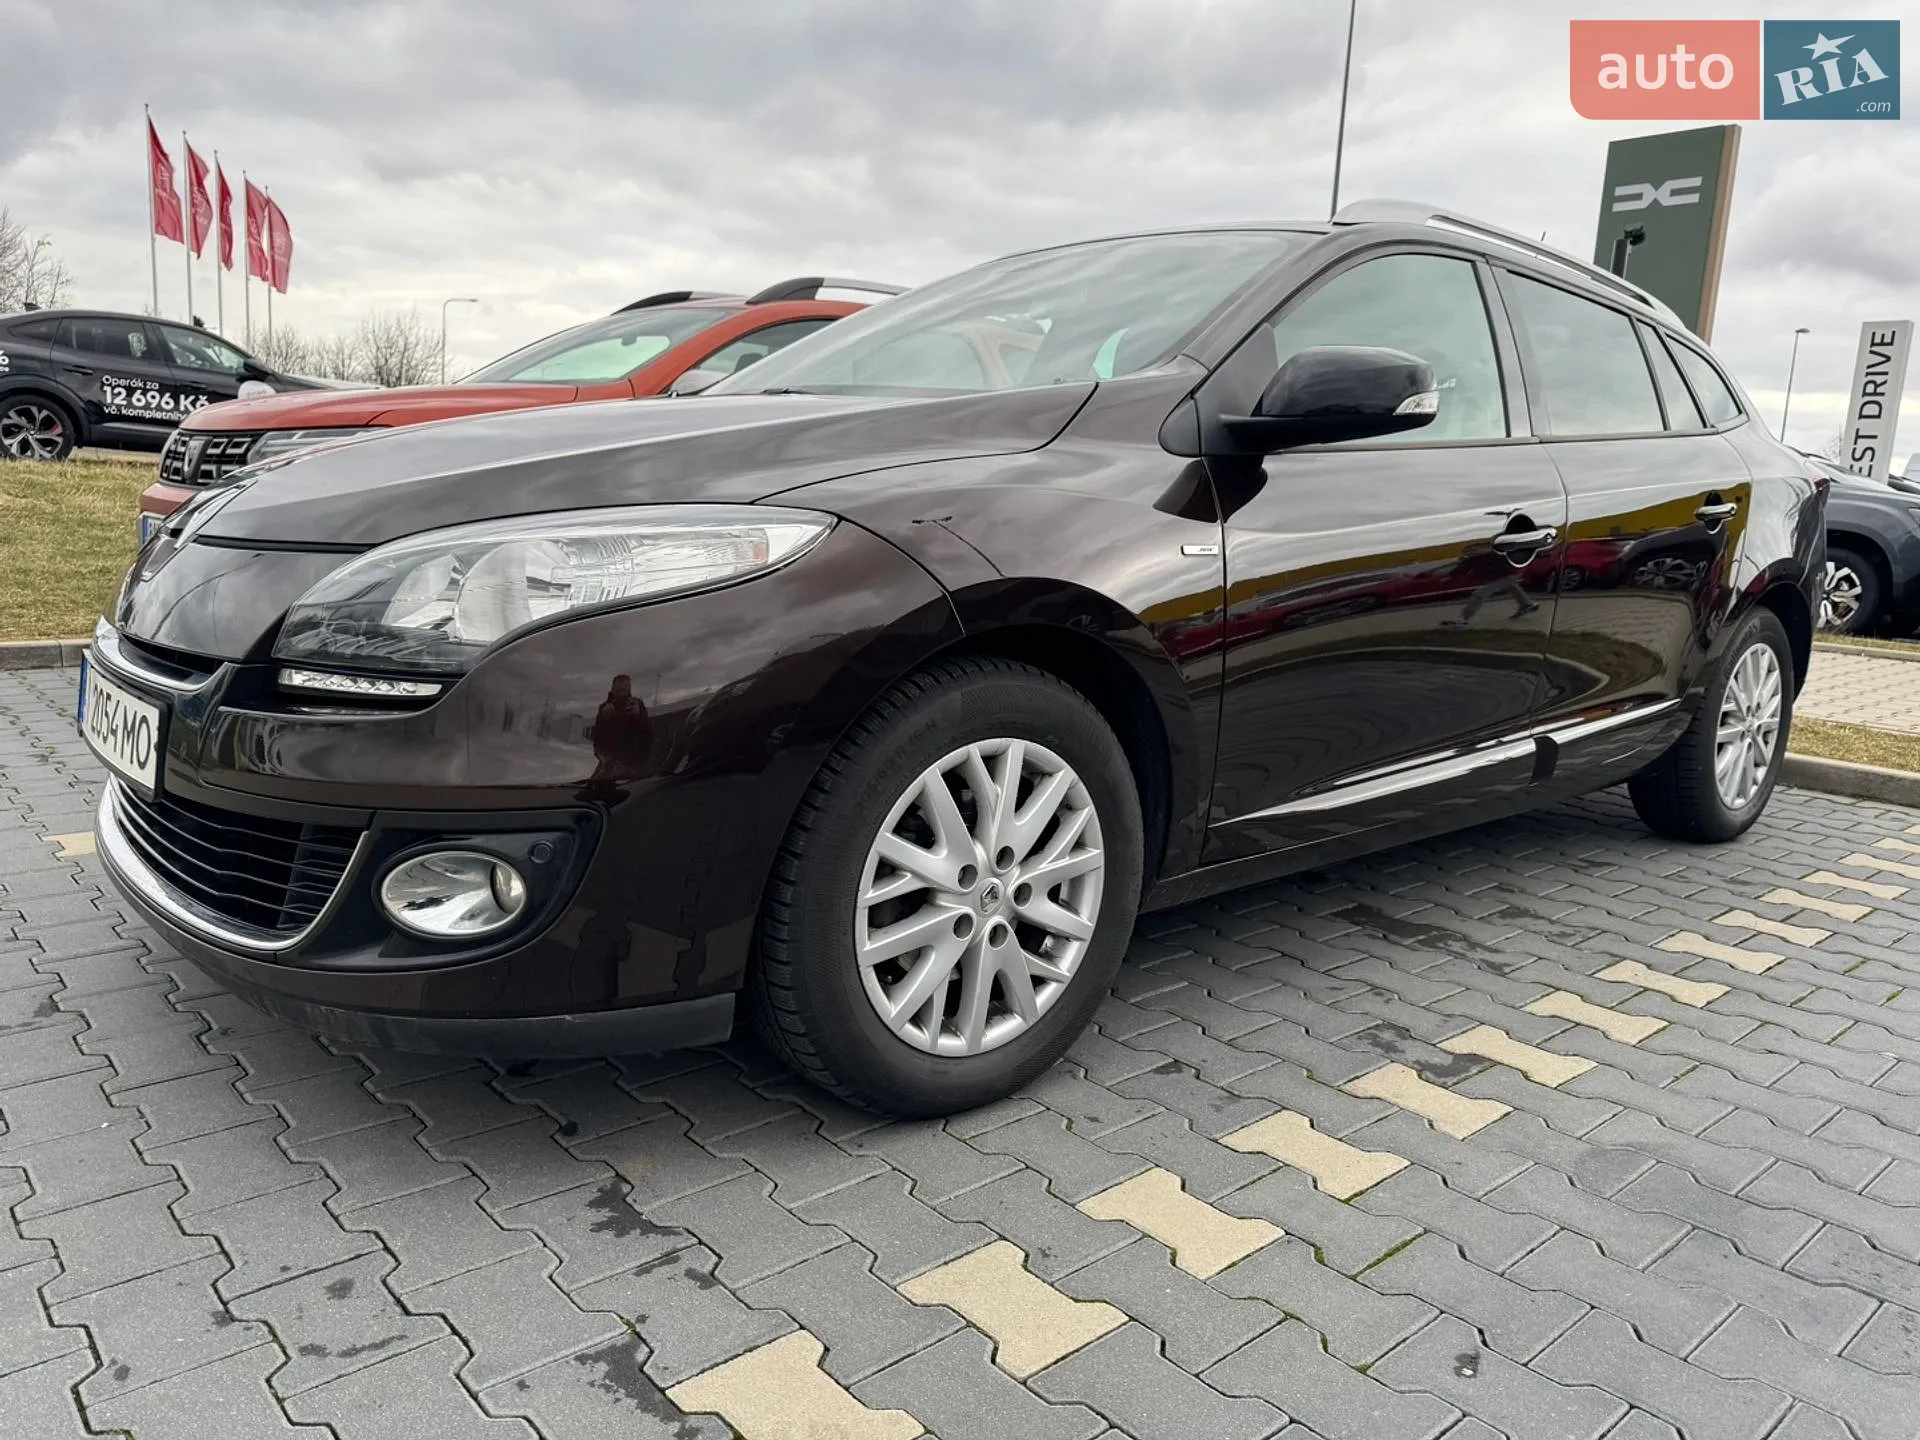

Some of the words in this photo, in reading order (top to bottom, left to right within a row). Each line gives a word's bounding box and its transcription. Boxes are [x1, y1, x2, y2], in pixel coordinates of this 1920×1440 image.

[102, 375, 144, 388] Operák
[146, 381, 159, 390] za
[1857, 330, 1896, 420] DRIVE
[103, 386, 127, 405] 12
[131, 389, 175, 410] 696
[179, 394, 209, 412] Kč
[1850, 428, 1878, 478] EST
